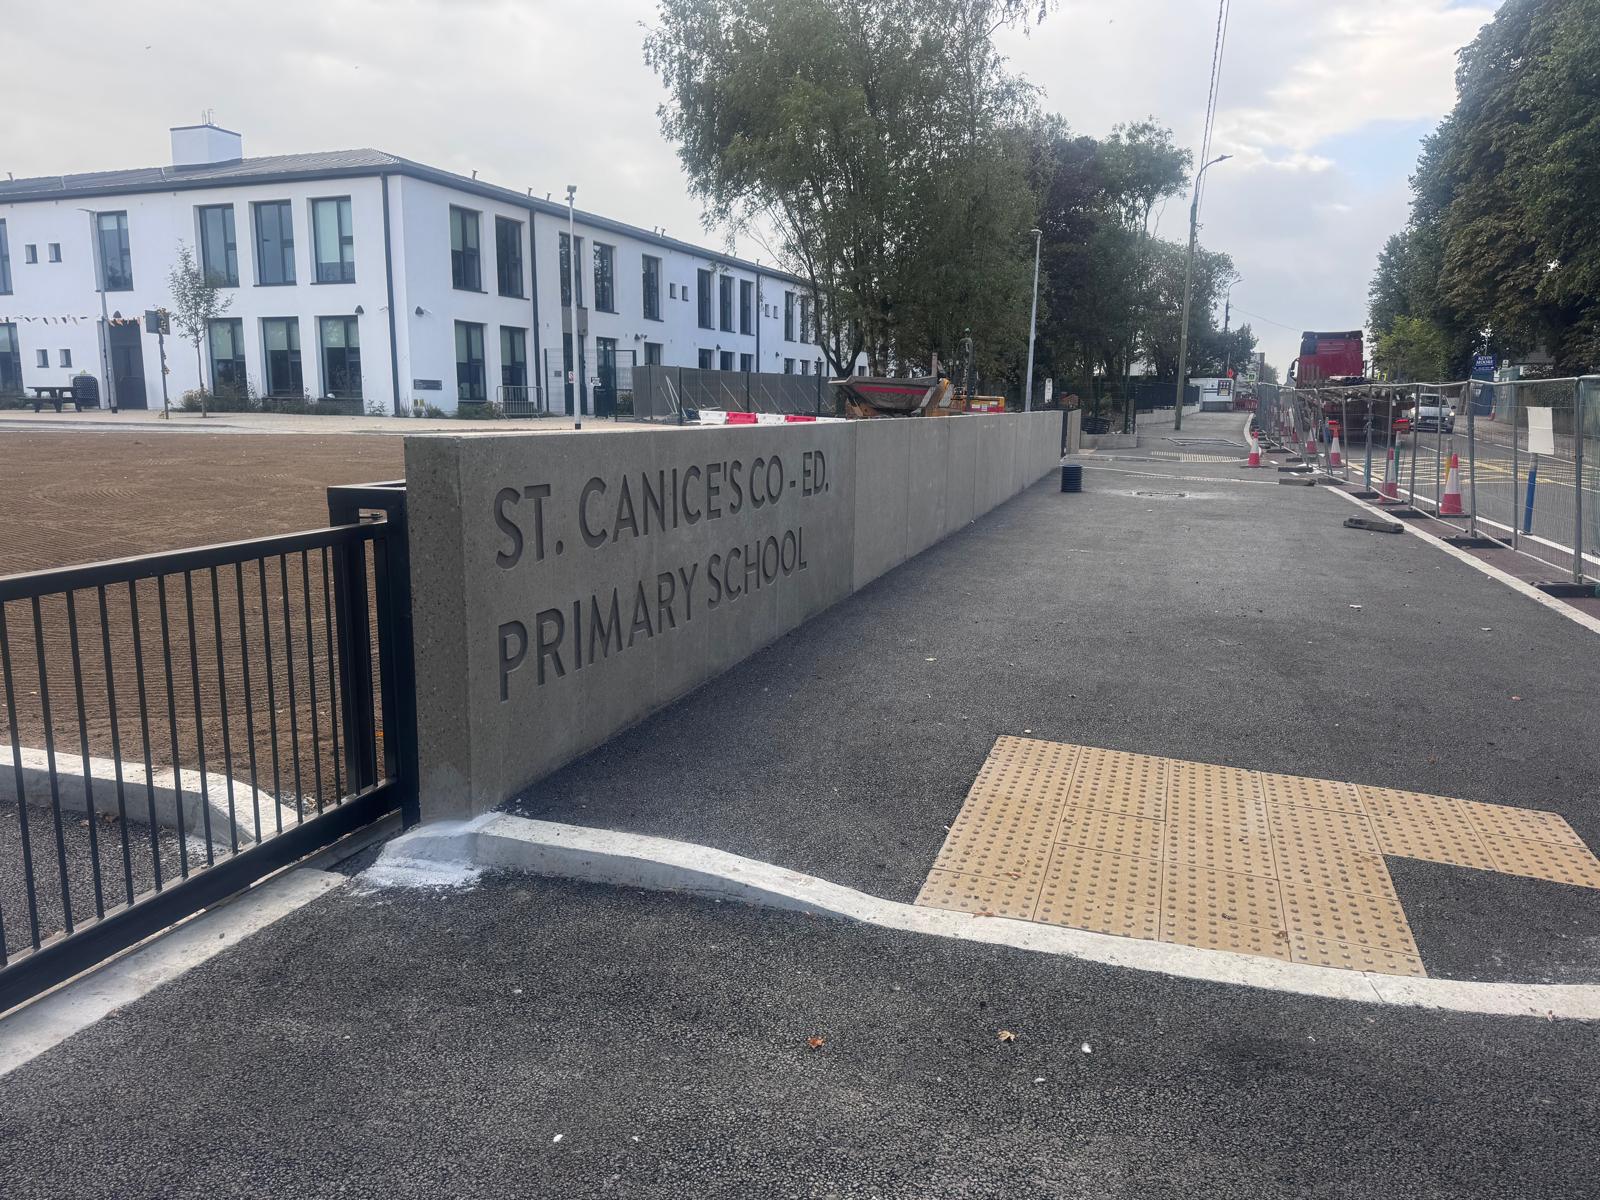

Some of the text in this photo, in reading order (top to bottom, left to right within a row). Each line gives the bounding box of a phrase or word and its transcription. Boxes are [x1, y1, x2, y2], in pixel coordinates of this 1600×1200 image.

[493, 483, 565, 570] ST.
[578, 459, 743, 549] CANICE'S
[498, 526, 808, 702] PRIMARY SCHOOL
